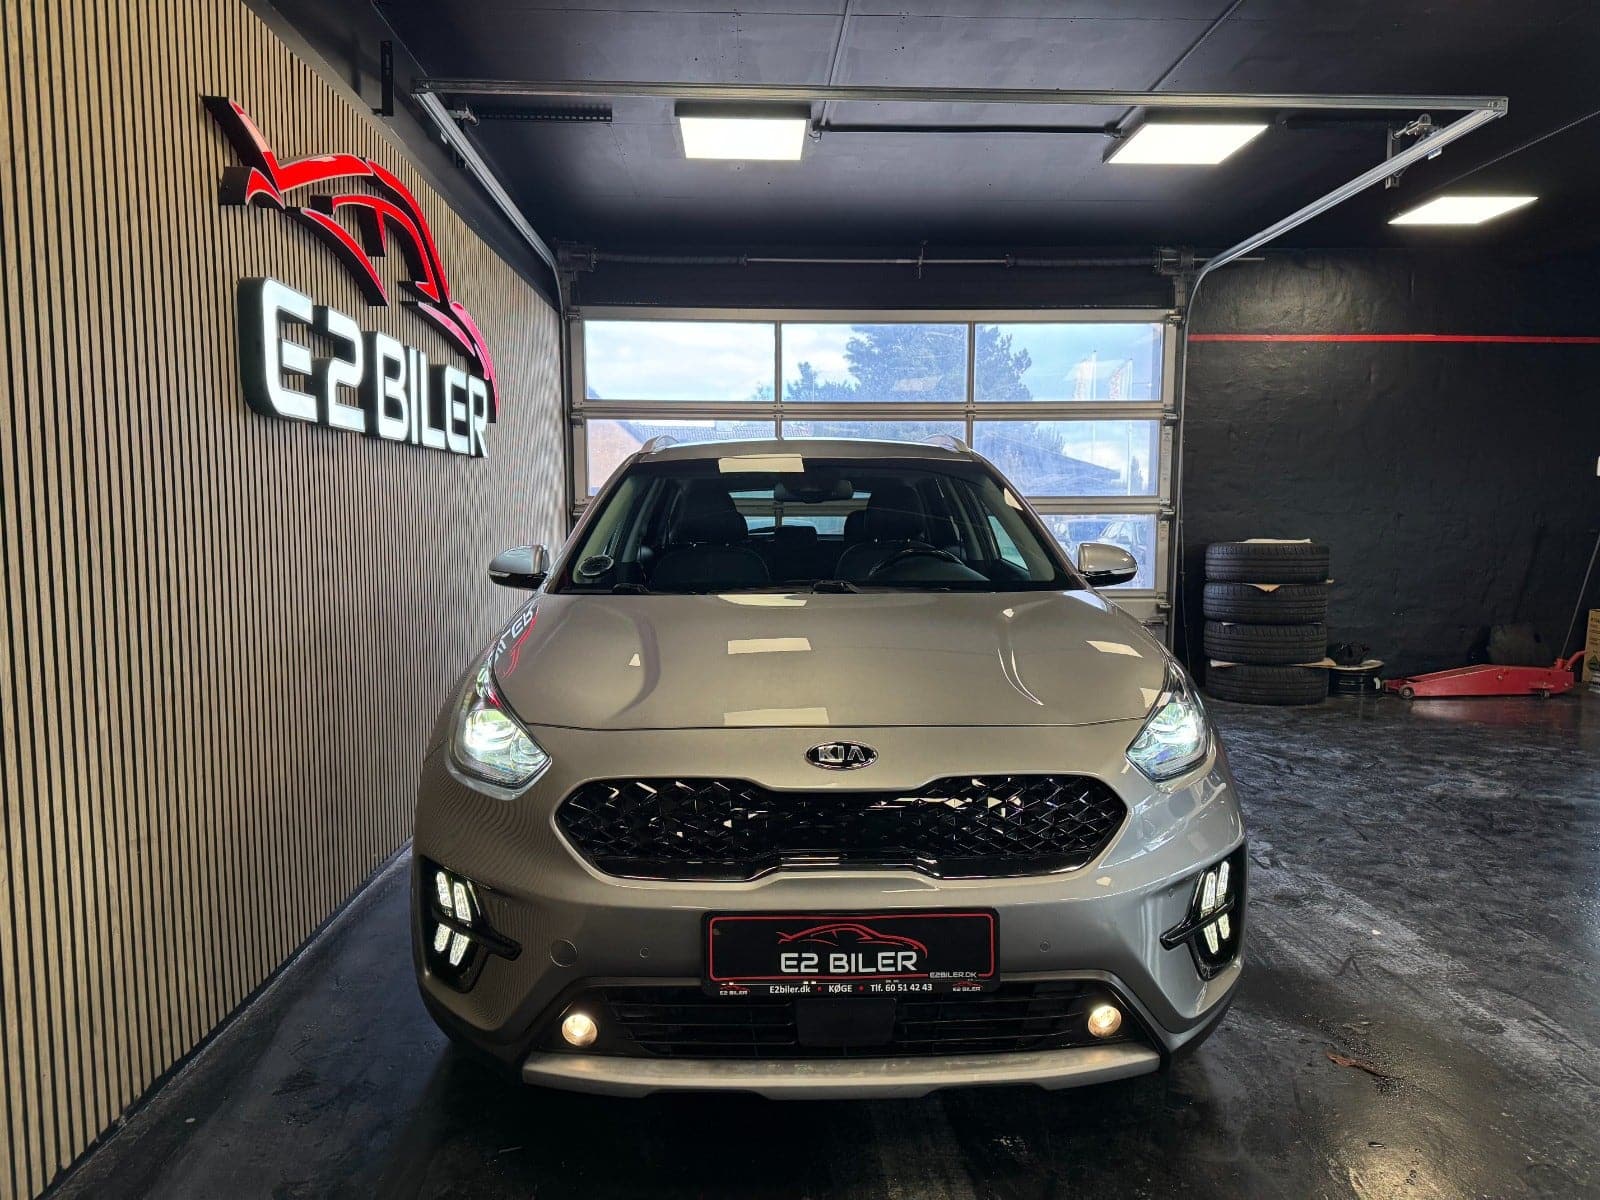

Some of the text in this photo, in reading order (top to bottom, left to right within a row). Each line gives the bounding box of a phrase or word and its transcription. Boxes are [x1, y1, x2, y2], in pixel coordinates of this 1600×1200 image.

[261, 277, 489, 459] E2 BILER
[818, 745, 866, 763] KIA
[780, 950, 918, 974] E2 BILER
[929, 971, 978, 979] E2BILER.DK
[769, 983, 933, 994] E2biler.dk KØGE Tlf. 60 51 42 43
